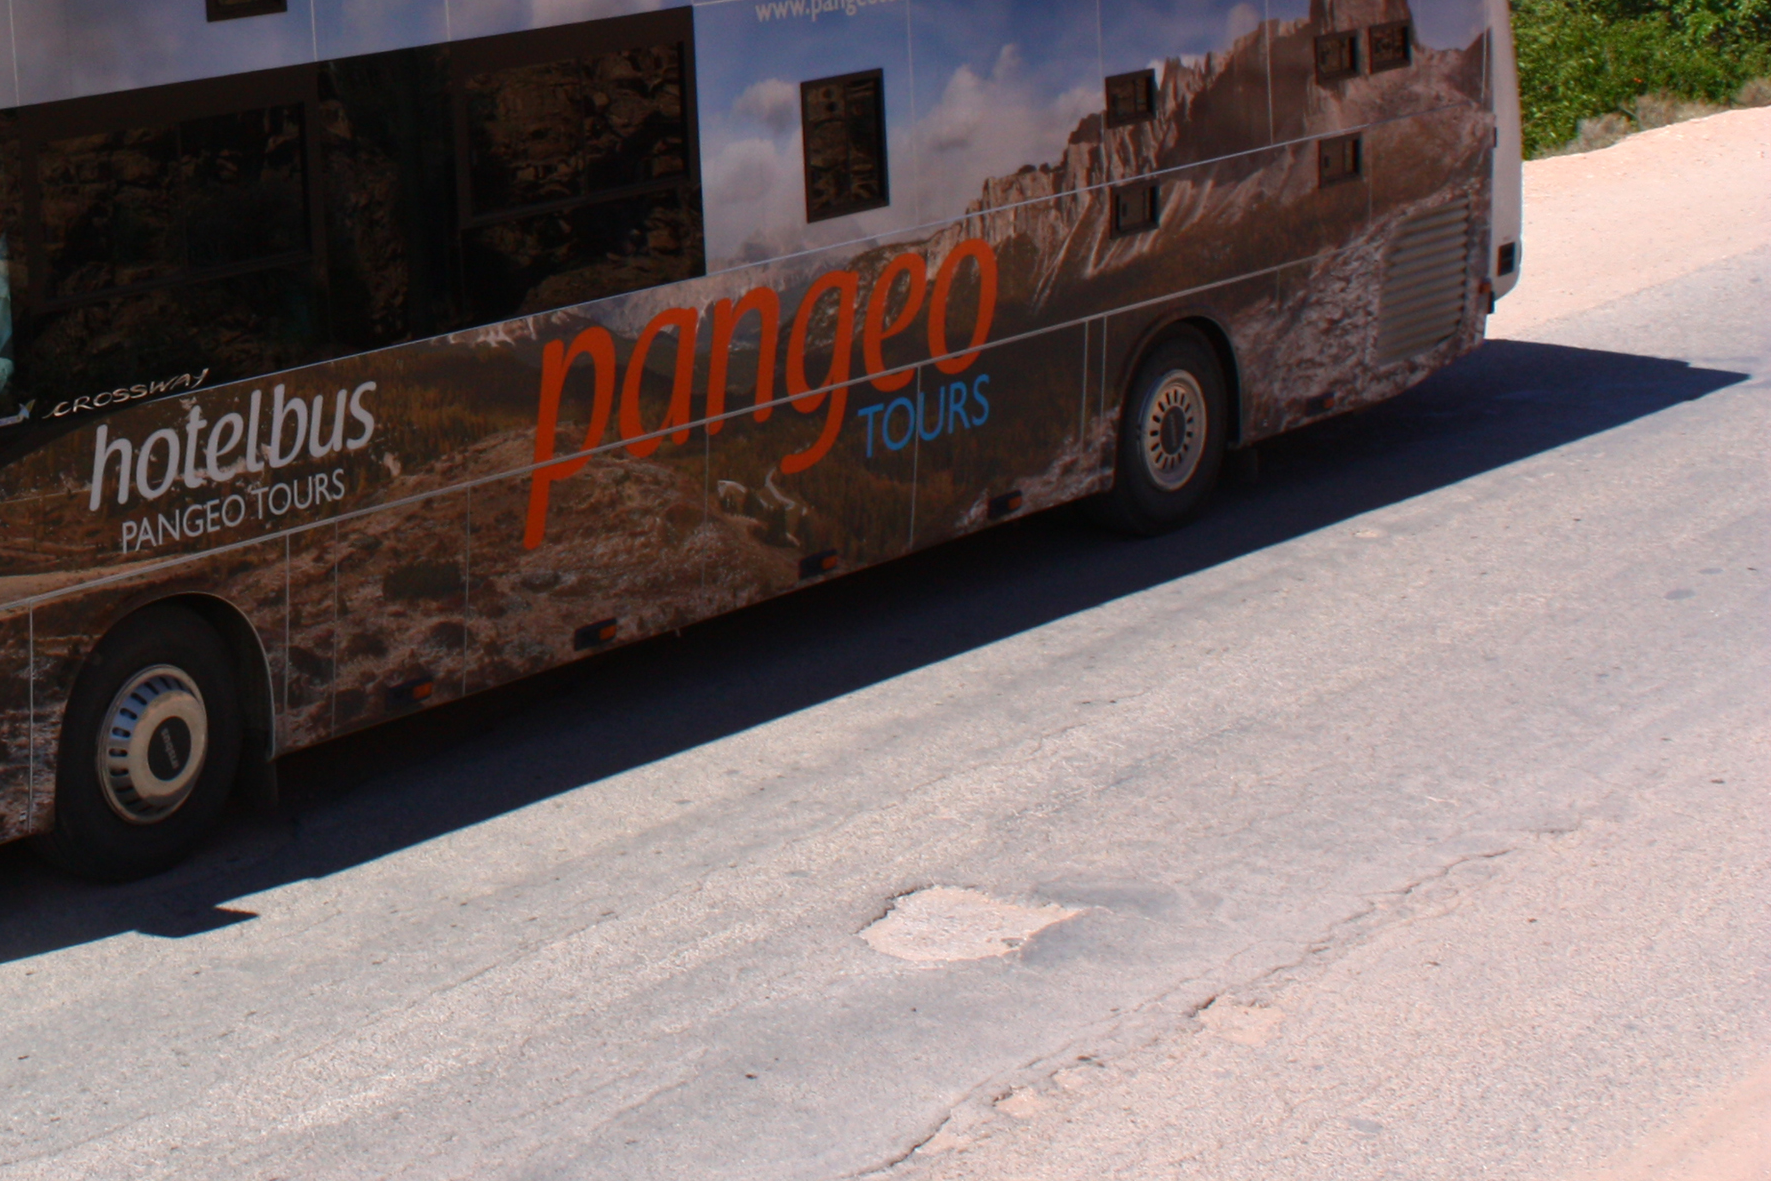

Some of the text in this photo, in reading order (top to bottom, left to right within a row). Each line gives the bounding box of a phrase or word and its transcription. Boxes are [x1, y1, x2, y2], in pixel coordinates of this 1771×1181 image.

[42, 368, 210, 419] CROSSWAY
[523, 238, 998, 550] pangeo
[858, 374, 990, 458] TOURS
[88, 380, 377, 511] hotelbus
[121, 468, 346, 554] PANGEO TOURS
